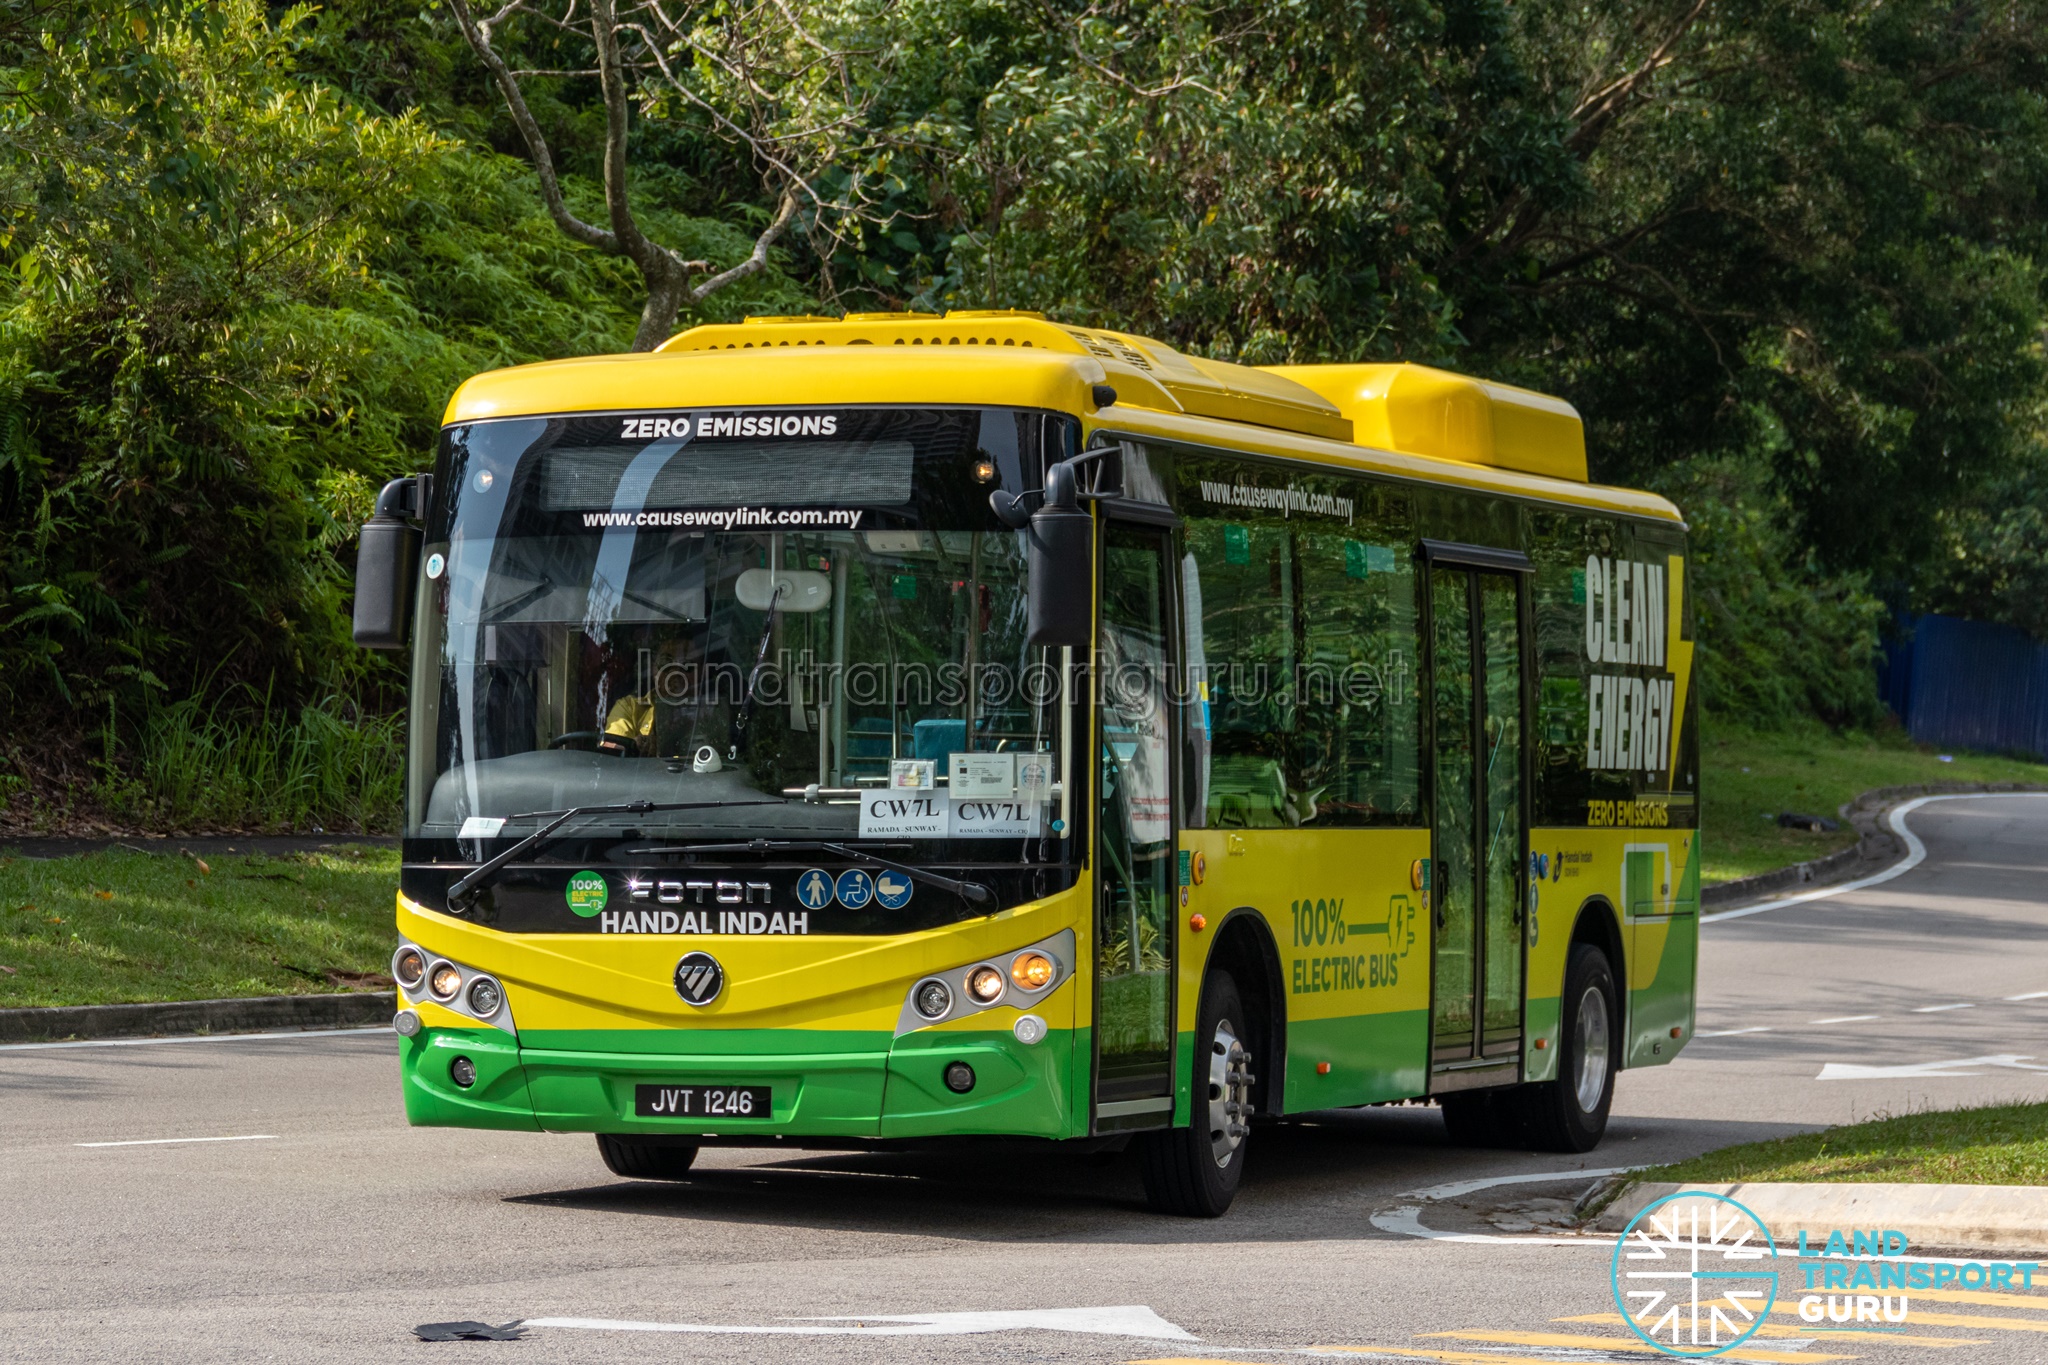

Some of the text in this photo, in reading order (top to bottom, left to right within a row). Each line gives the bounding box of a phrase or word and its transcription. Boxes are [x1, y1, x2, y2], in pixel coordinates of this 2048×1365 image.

[621, 416, 837, 438] ZERO EMISSIONS
[1200, 480, 1354, 526] www.causewaylink.com.my
[583, 507, 862, 530] www.causewaylink.com.my
[1586, 554, 1664, 666] CLEAN
[1587, 675, 1673, 771] ENERGY
[870, 799, 940, 818] CW7L
[958, 802, 1030, 821] CW7L
[1587, 801, 1668, 827] ZERO EMISSIONS
[571, 880, 603, 890] 100%
[630, 881, 771, 903] FOTON
[601, 911, 808, 934] HANDAL INDAH
[1291, 898, 1345, 947] 100%
[1293, 953, 1398, 994] ELECTRIC BUS
[651, 1089, 753, 1114] JVT 1246
